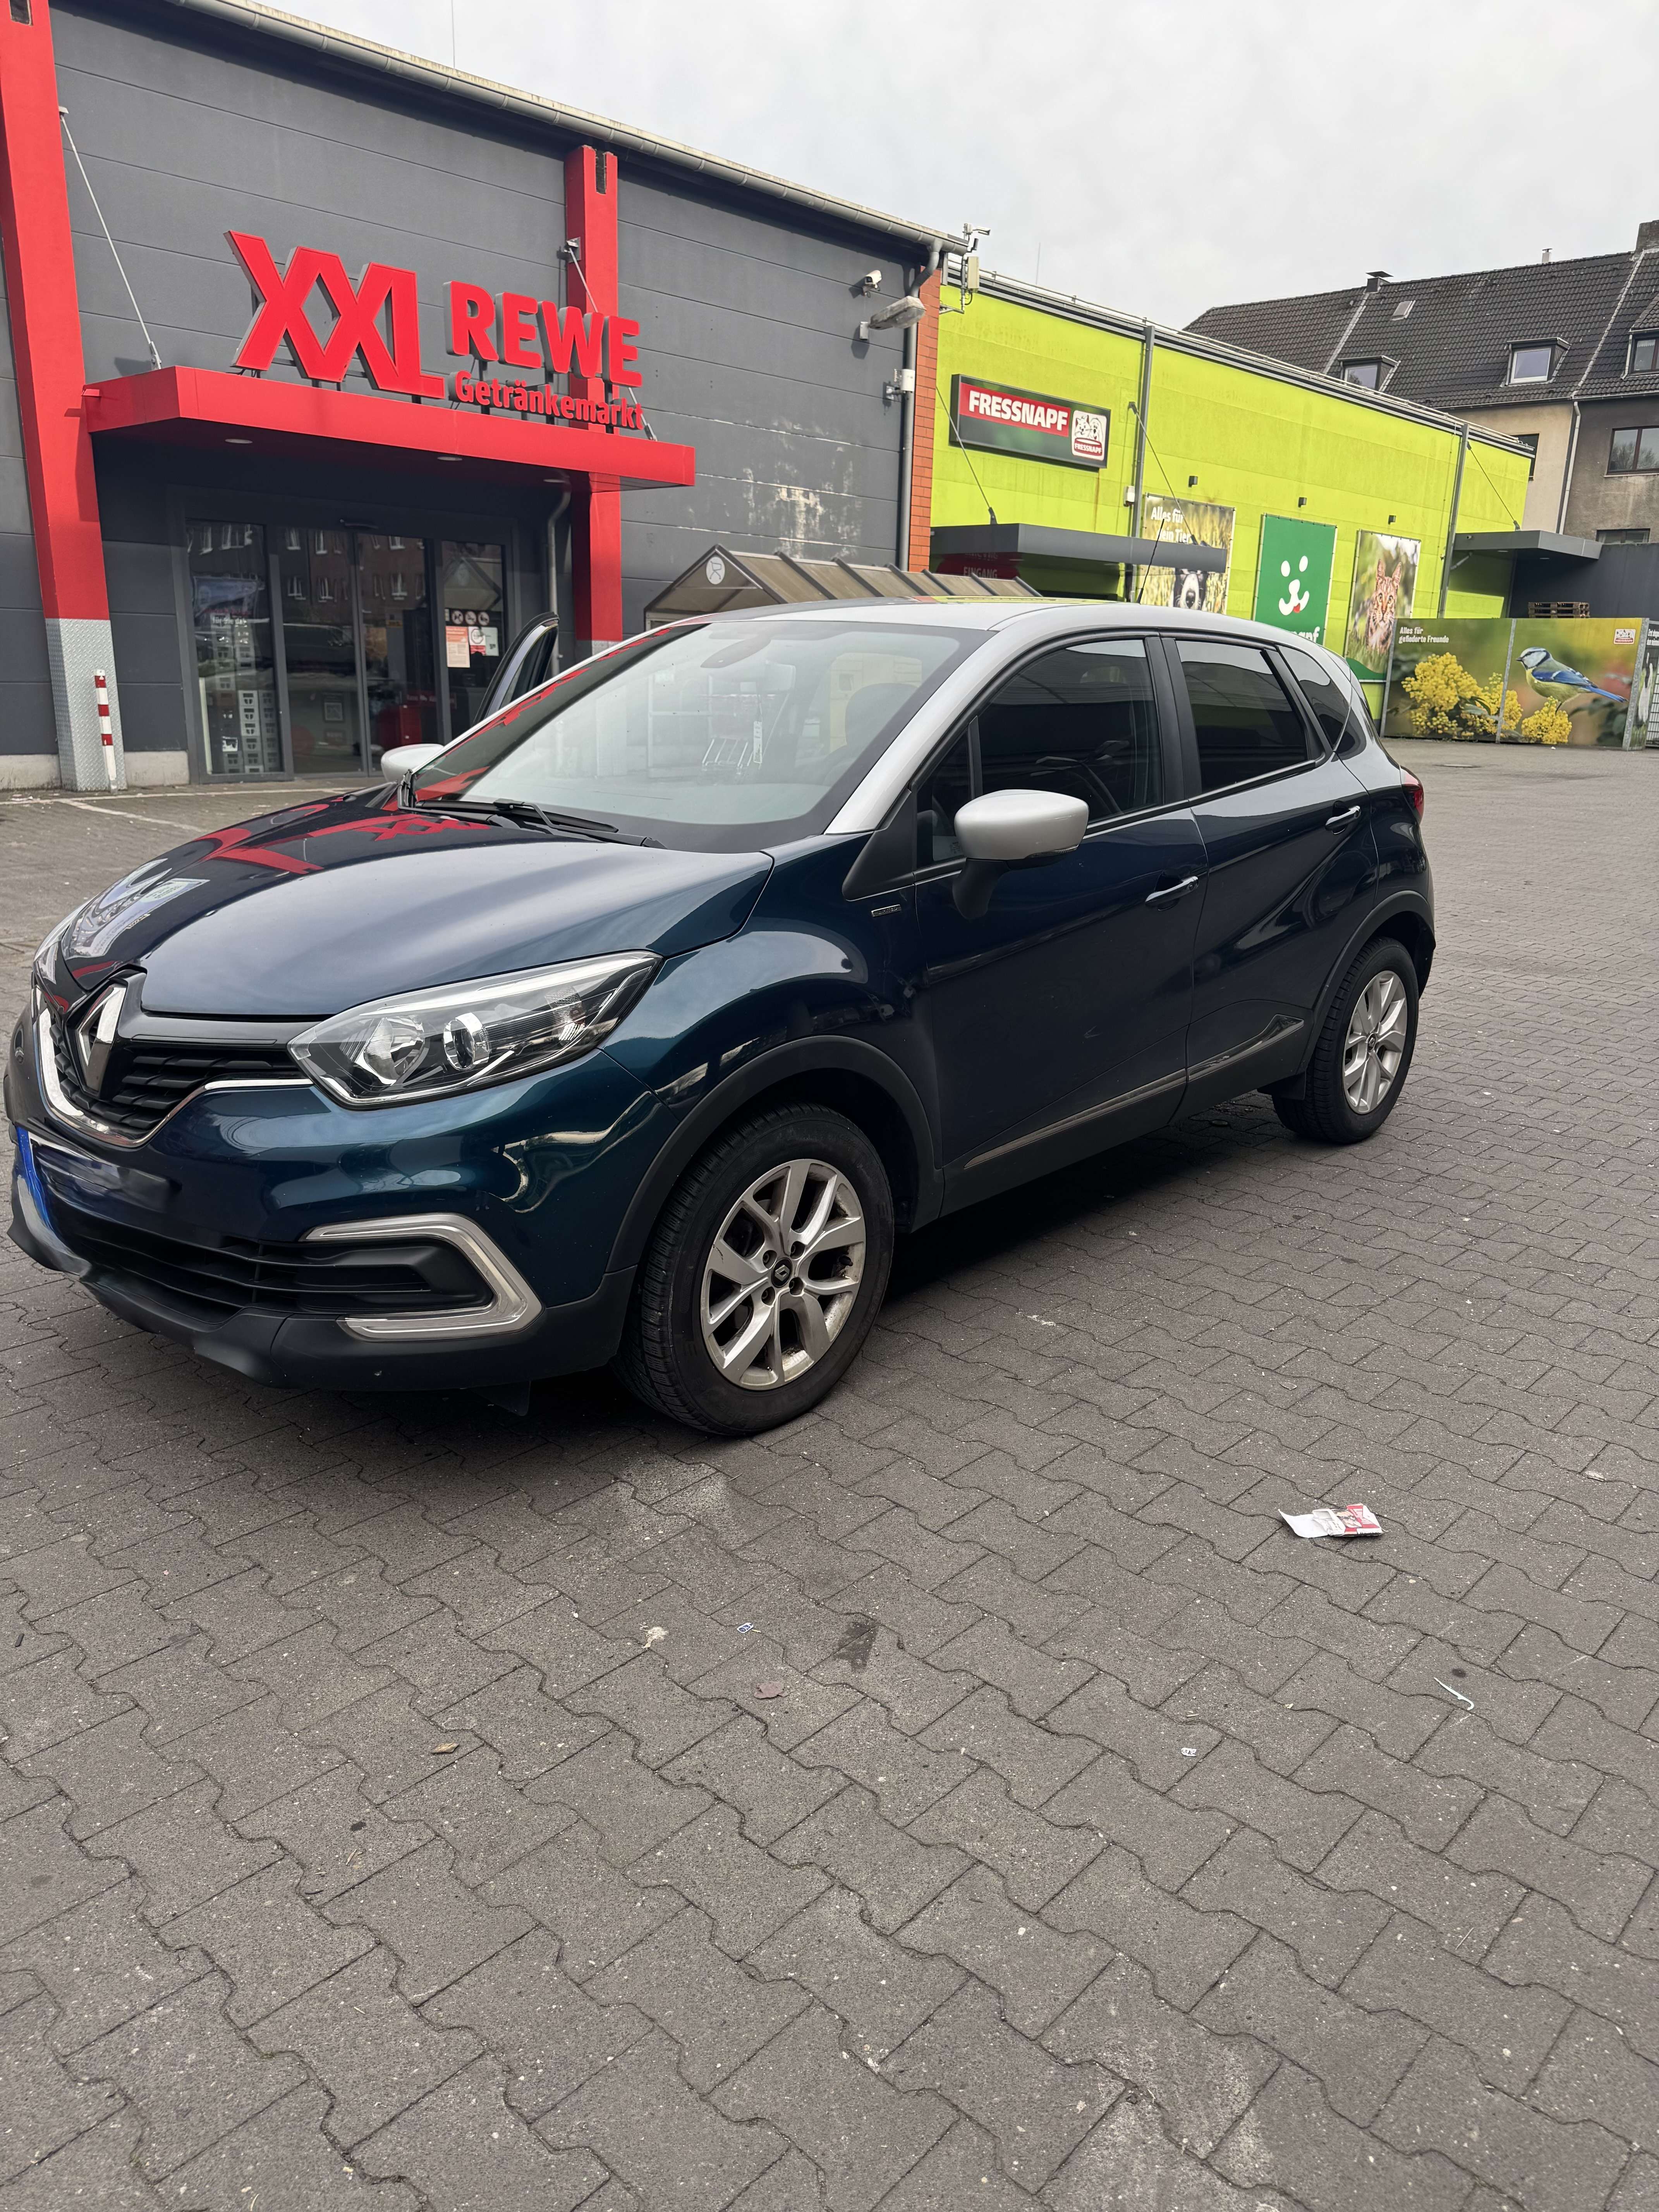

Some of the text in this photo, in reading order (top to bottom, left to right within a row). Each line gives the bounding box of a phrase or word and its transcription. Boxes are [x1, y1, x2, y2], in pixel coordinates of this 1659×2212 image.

[225, 230, 643, 399] XXL REWE
[454, 370, 644, 430] Getränkemarkt
[969, 390, 1068, 431] FRESSNAPF
[1075, 443, 1102, 454] FRESSNAPF
[1151, 506, 1184, 524] Alles für
[1175, 529, 1192, 543] Tier
[963, 566, 998, 578] EINGANG
